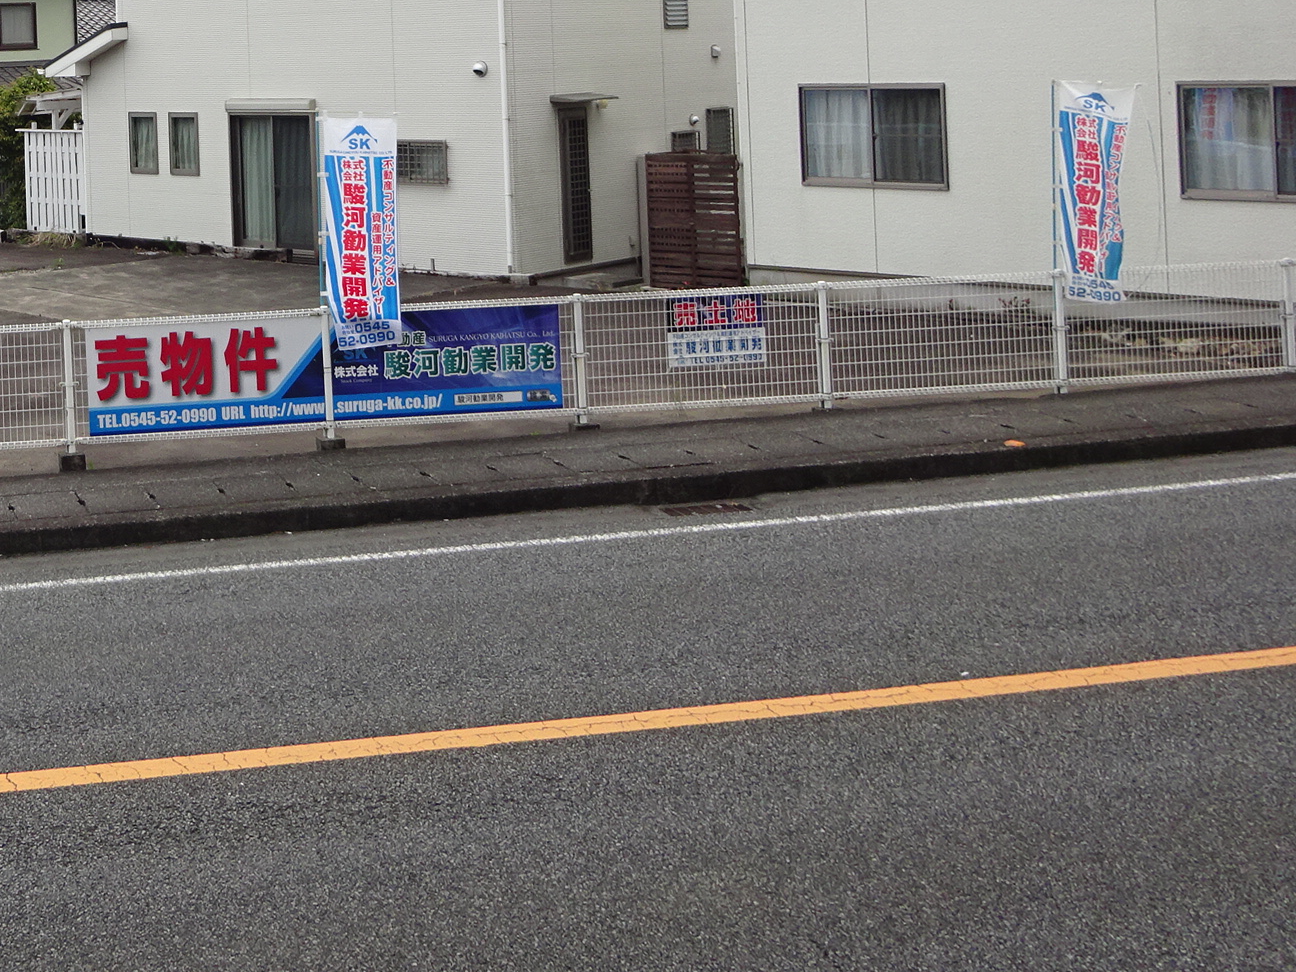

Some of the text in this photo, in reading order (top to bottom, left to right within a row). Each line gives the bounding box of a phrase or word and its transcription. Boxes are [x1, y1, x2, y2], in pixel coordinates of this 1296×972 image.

[1083, 99, 1106, 113] SK
[348, 138, 371, 150] SK
[342, 159, 365, 170] 株式
[342, 171, 365, 182] 会社
[341, 183, 368, 320] 駿河勧業開発
[371, 213, 385, 314] 資産運用アドバイザー
[673, 299, 757, 326] 売土地
[354, 321, 391, 334] 0545
[338, 330, 396, 347] 52-0990
[428, 335, 458, 343] SURUGA
[459, 333, 489, 341] KANGYO
[94, 327, 278, 401] 売物件
[384, 342, 556, 380] 駿河勧業開発
[333, 364, 379, 378] 株式会社
[96, 407, 217, 429] TEL.0545-52-0990
[221, 404, 246, 420] URL
